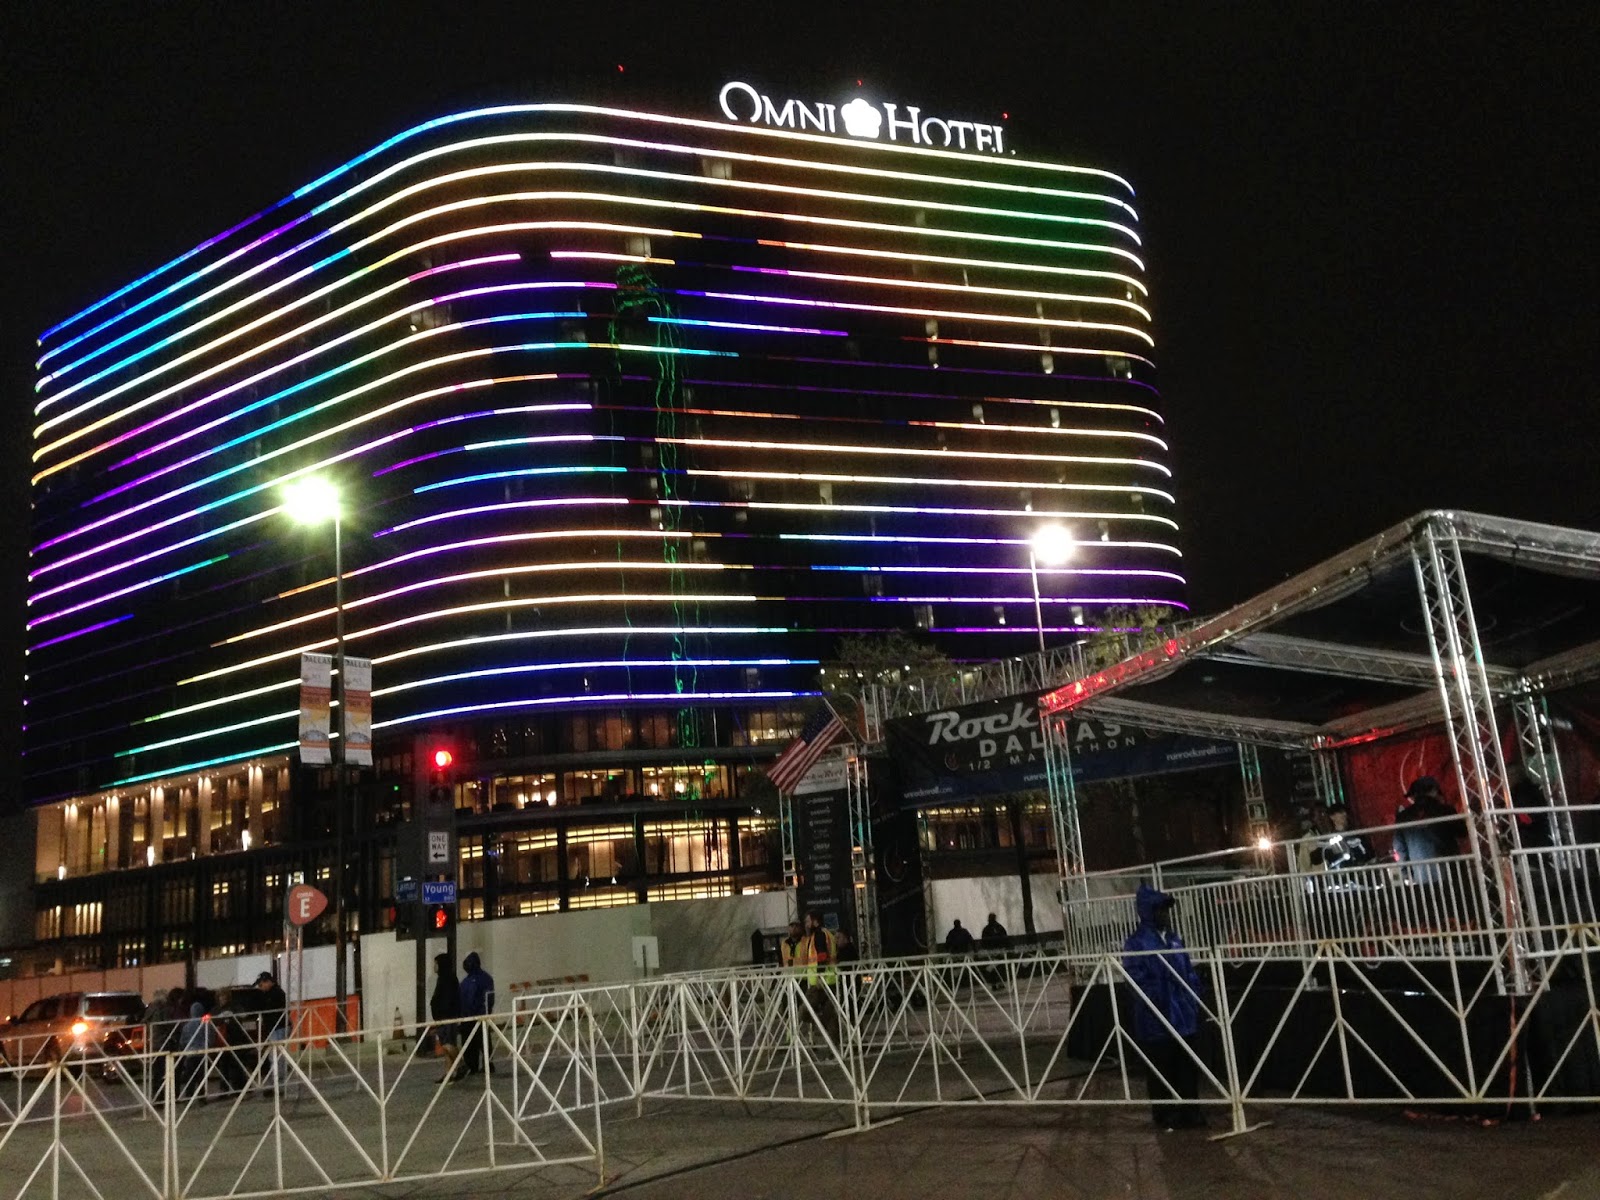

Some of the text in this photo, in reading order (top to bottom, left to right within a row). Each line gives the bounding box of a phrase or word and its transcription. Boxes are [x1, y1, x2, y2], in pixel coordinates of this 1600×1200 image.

[719, 81, 1014, 154] OMNI HOTEL
[926, 702, 1039, 745] Rock
[969, 759, 991, 771] 1/2
[431, 834, 445, 842] ONE
[425, 884, 454, 895] Young
[300, 898, 310, 918] E
